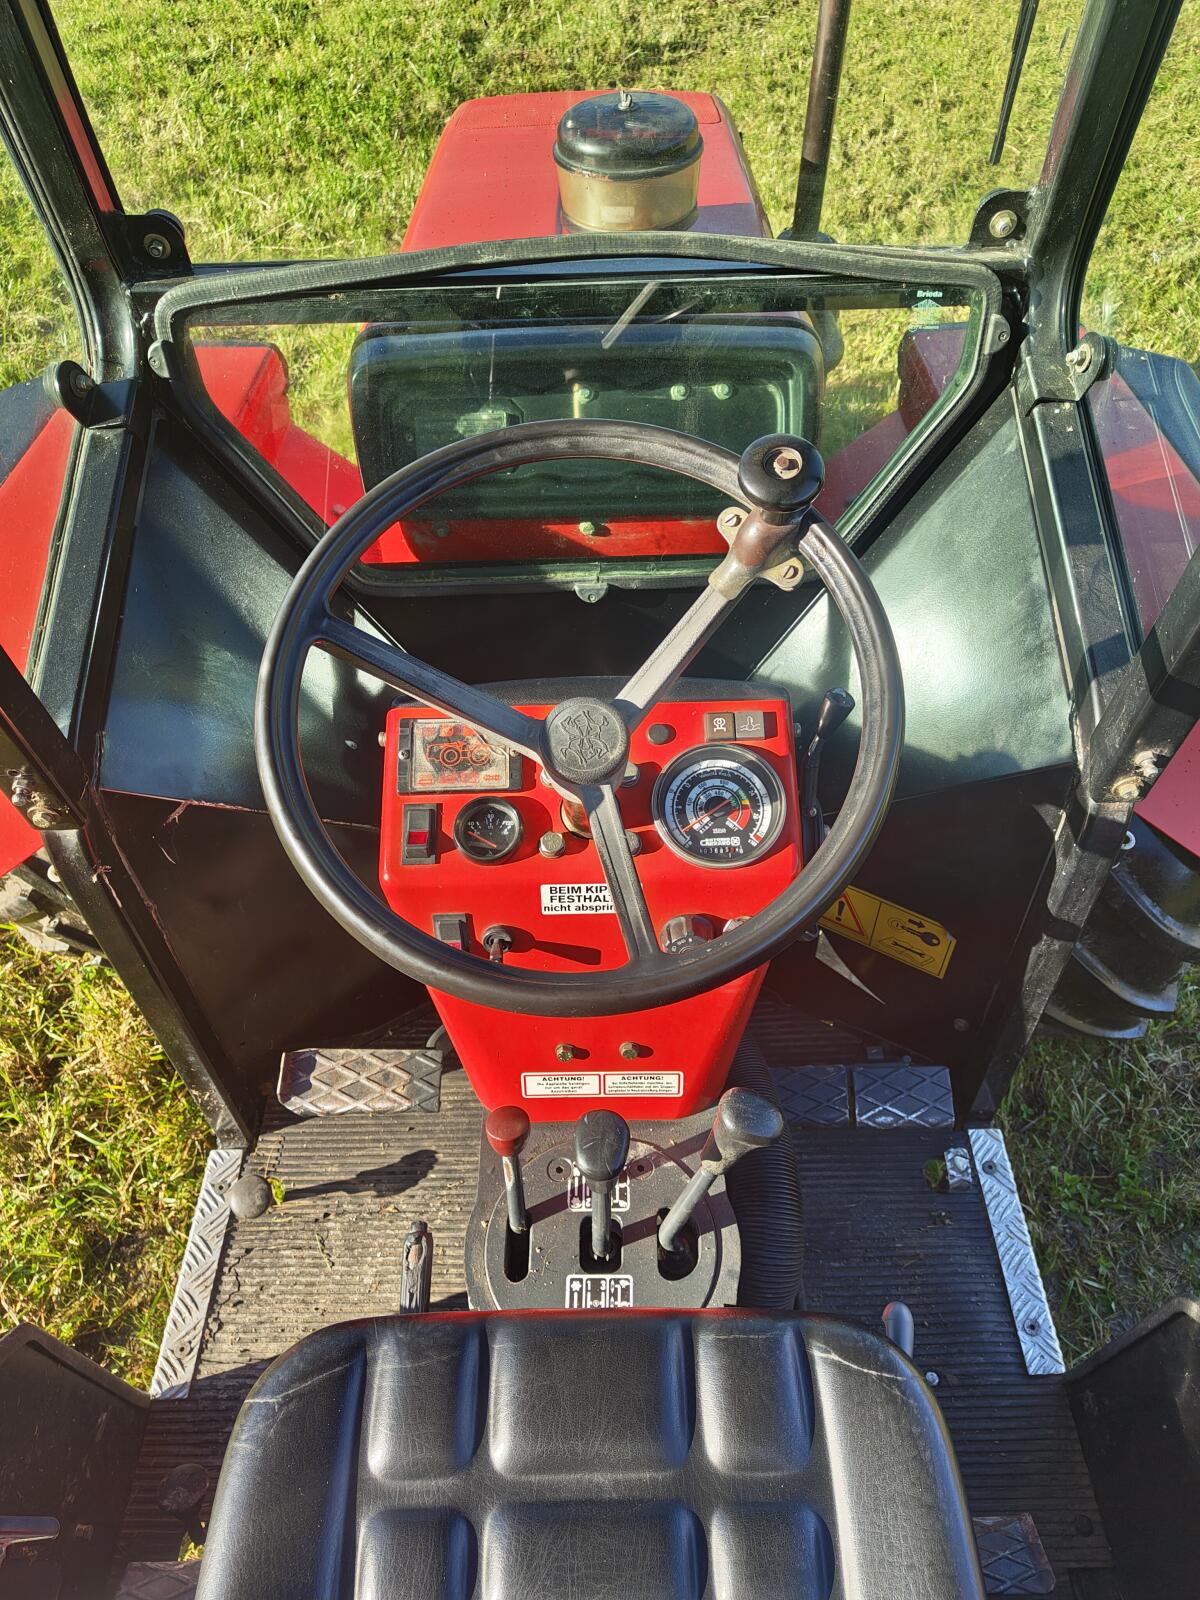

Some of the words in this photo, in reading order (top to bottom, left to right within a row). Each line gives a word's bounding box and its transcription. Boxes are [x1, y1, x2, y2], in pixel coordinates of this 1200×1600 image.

[549, 886, 582, 895] BEIM
[585, 885, 608, 894] KIP
[550, 894, 613, 903] FESTHAL
[600, 1280, 606, 1291] 3
